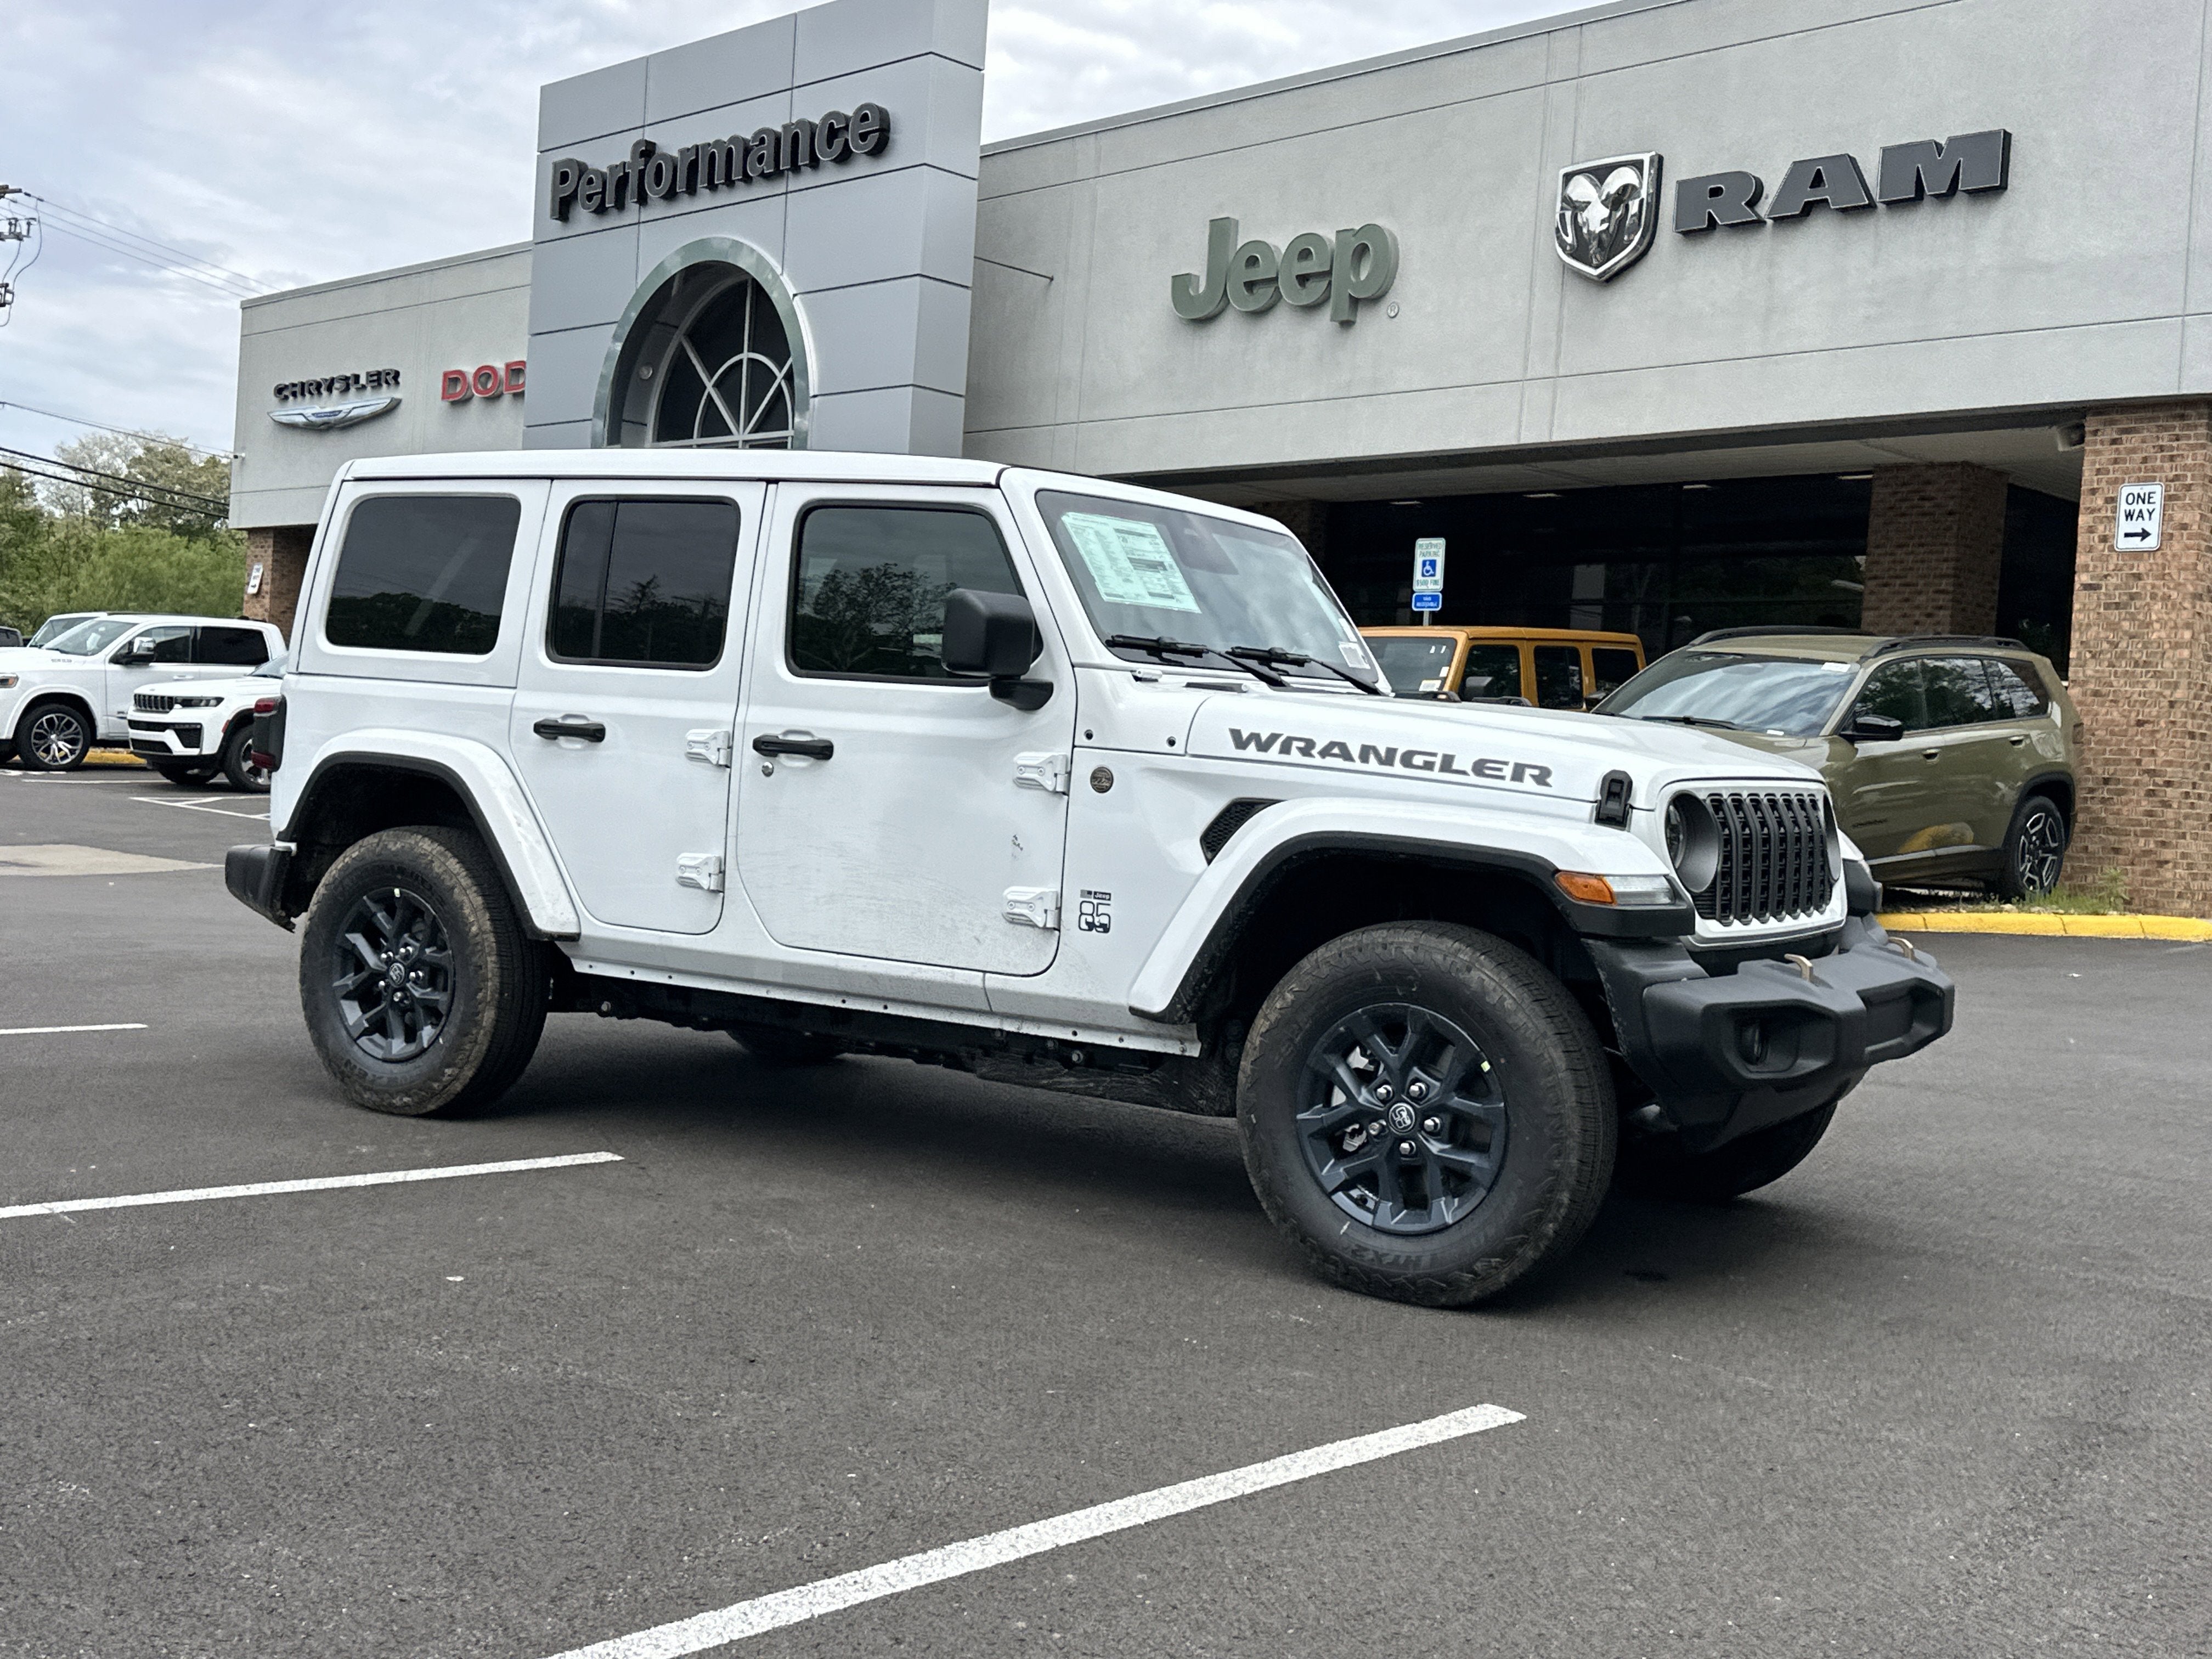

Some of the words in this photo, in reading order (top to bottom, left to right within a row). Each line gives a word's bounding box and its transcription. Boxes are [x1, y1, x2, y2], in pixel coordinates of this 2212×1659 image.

[550, 102, 890, 221] Performance
[1673, 129, 2012, 234] RAM
[1171, 217, 1400, 327] Jeep
[273, 368, 400, 400] CHRYSLER
[2124, 508, 2156, 522] WAY
[2125, 492, 2156, 505] ONE
[1228, 728, 1553, 788] WRANGLER
[1078, 900, 1111, 934] 85
